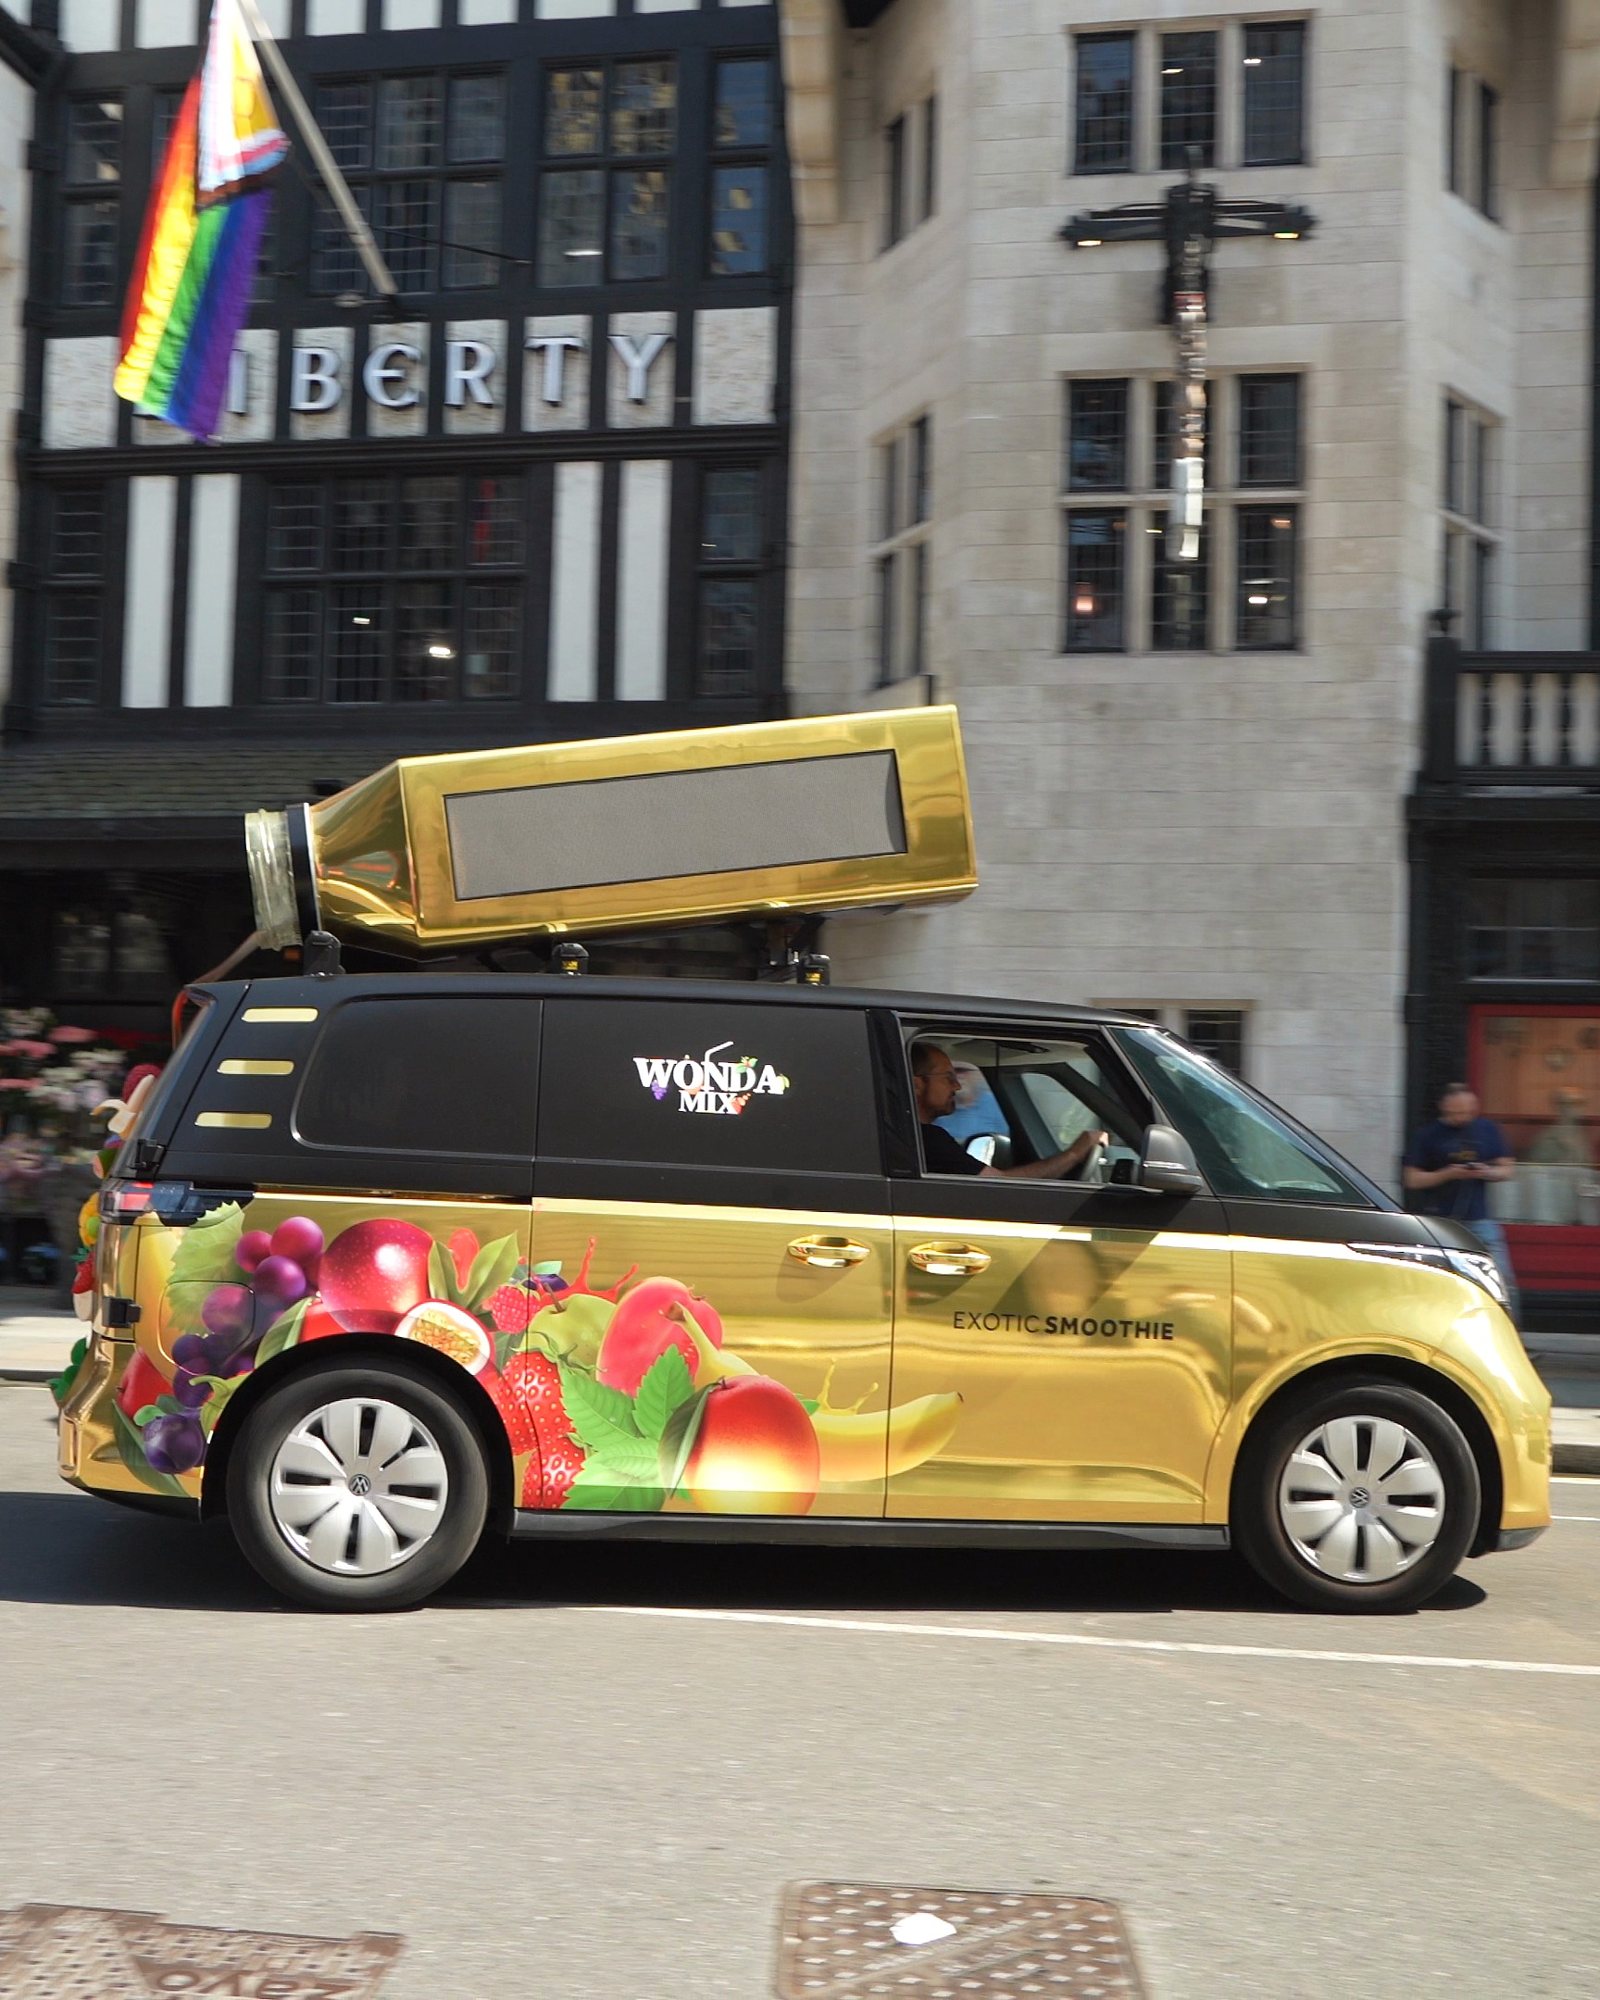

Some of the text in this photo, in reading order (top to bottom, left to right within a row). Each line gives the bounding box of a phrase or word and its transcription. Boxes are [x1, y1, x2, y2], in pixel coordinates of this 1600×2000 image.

[136, 334, 674, 418] IBERTY
[633, 1056, 785, 1095] WONDA
[678, 1090, 739, 1115] MIX
[953, 1311, 1175, 1341] EXOTIC SMOOTHIE
